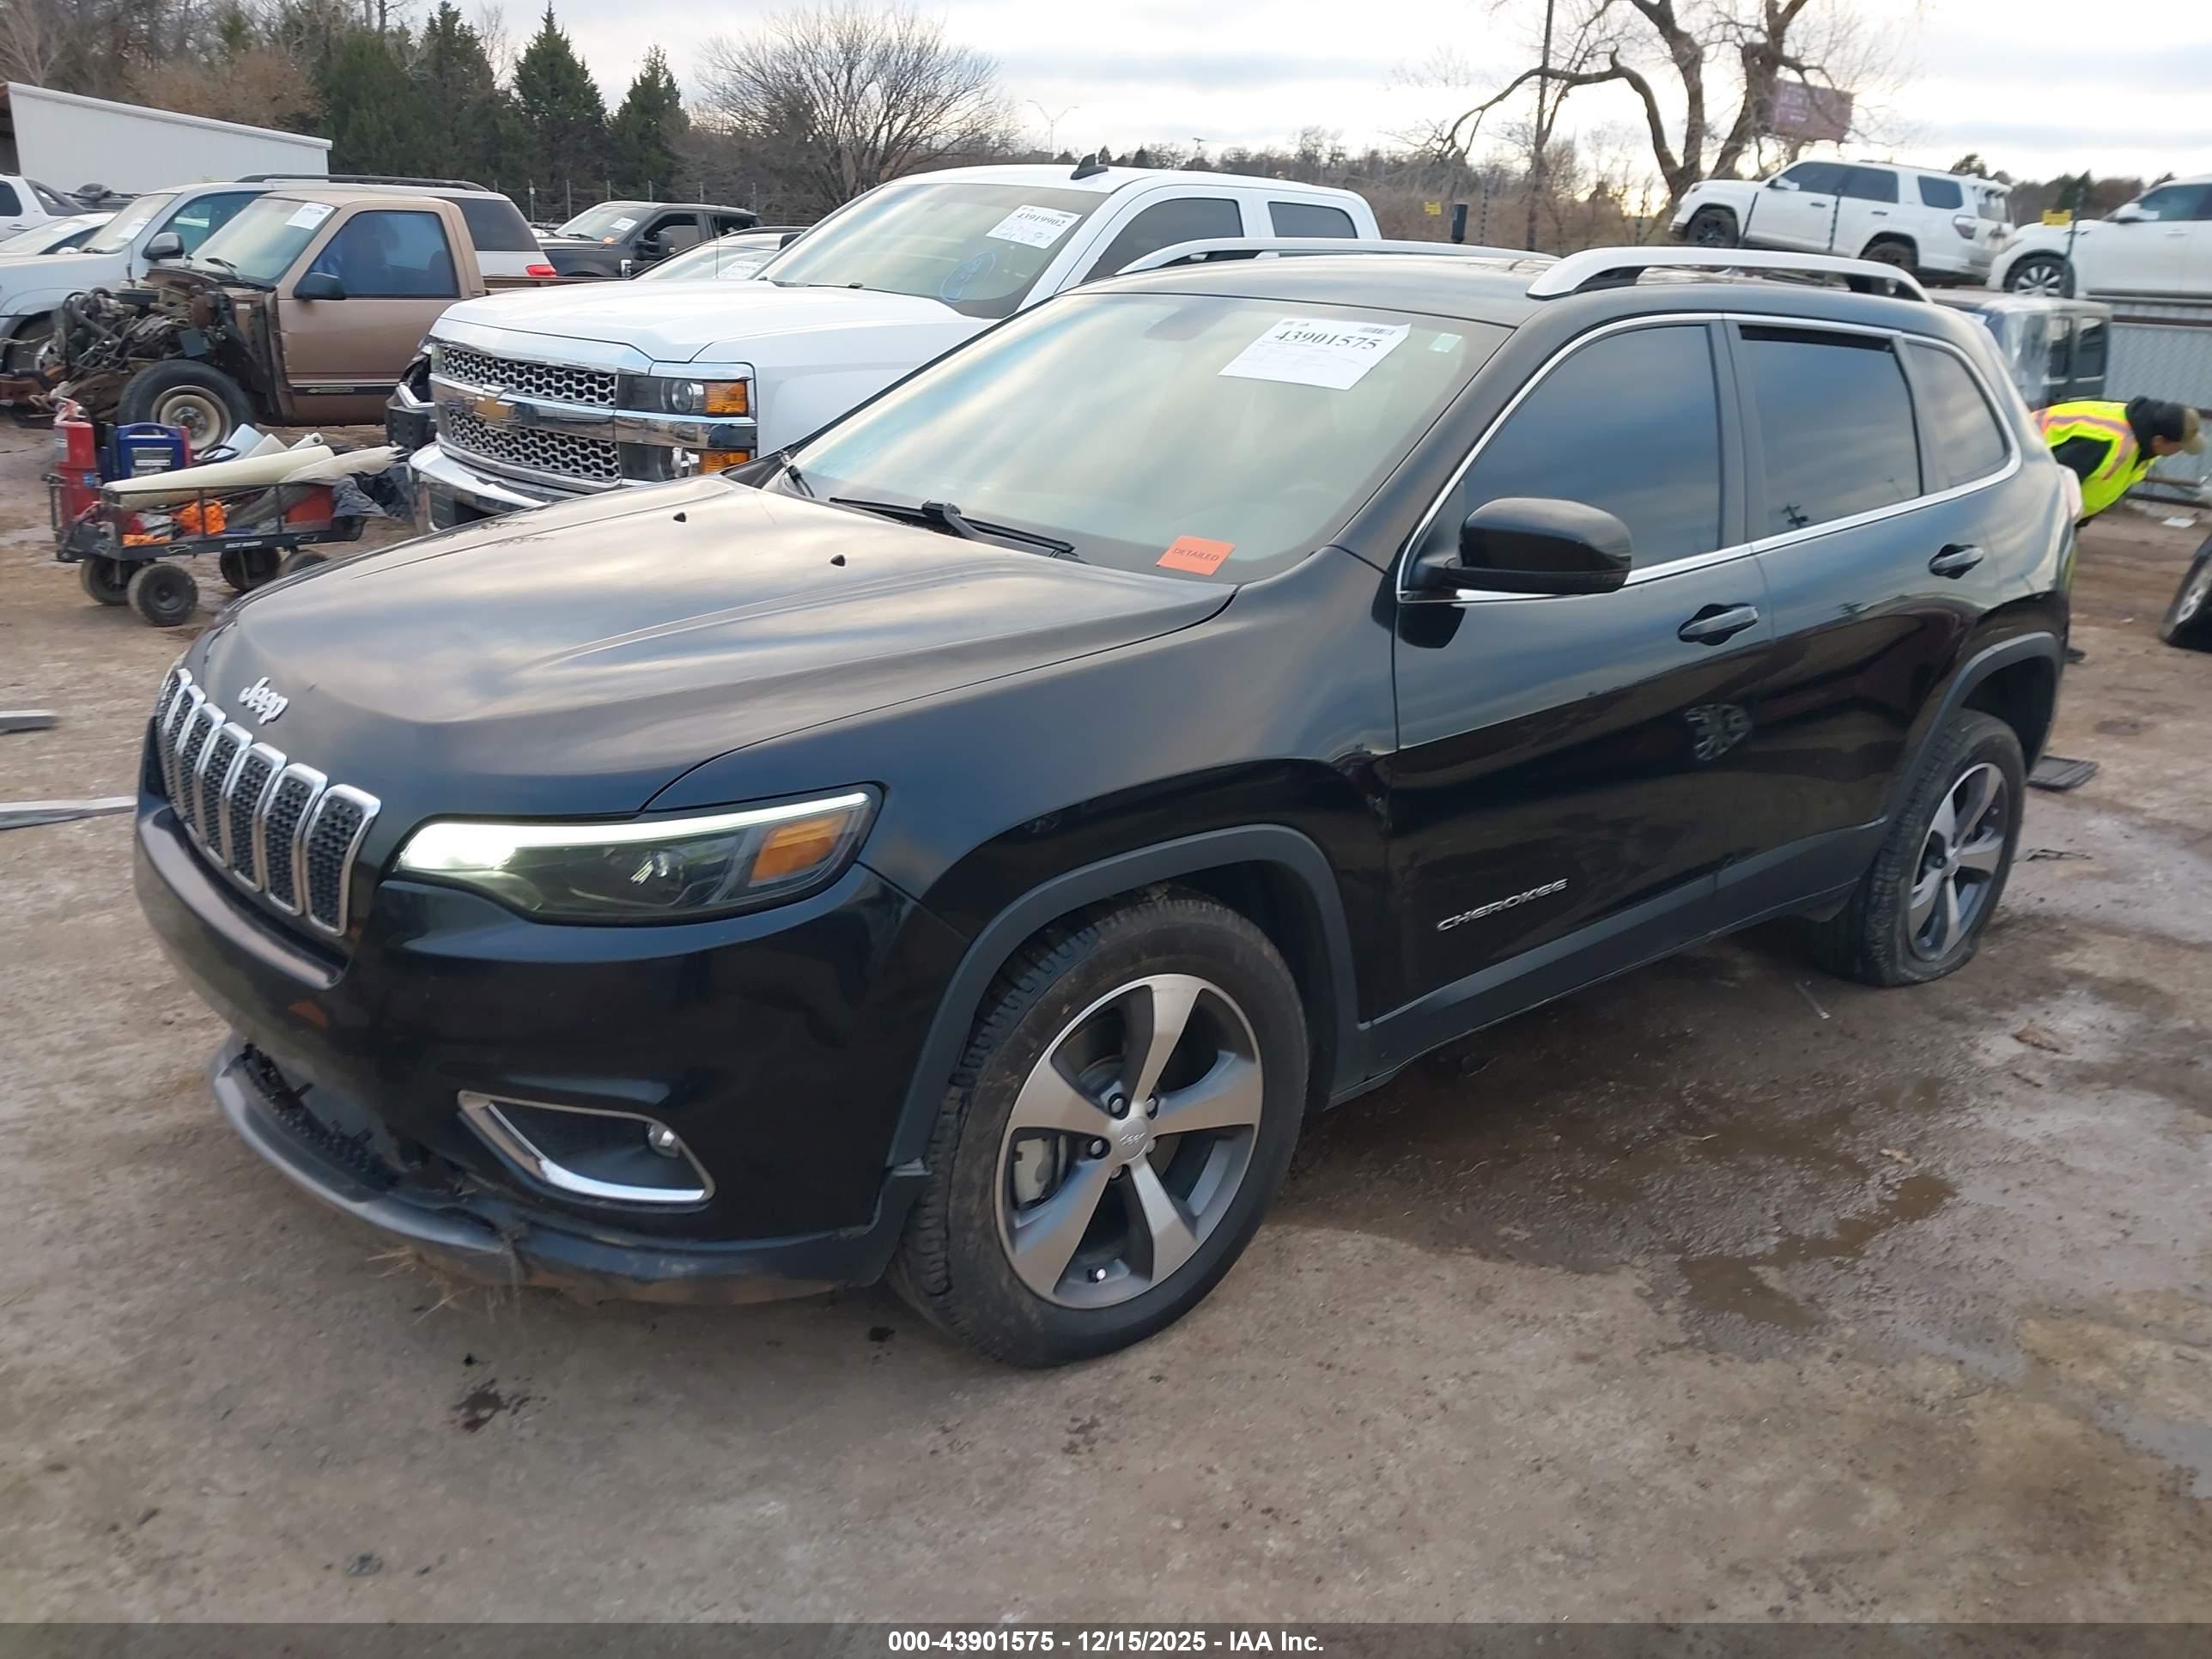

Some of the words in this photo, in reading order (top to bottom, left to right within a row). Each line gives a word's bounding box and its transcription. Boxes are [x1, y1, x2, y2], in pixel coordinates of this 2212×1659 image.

[1274, 329, 1382, 350] 43901575
[238, 676, 289, 726] Jeep
[1436, 878, 1569, 932] CHEROKEE
